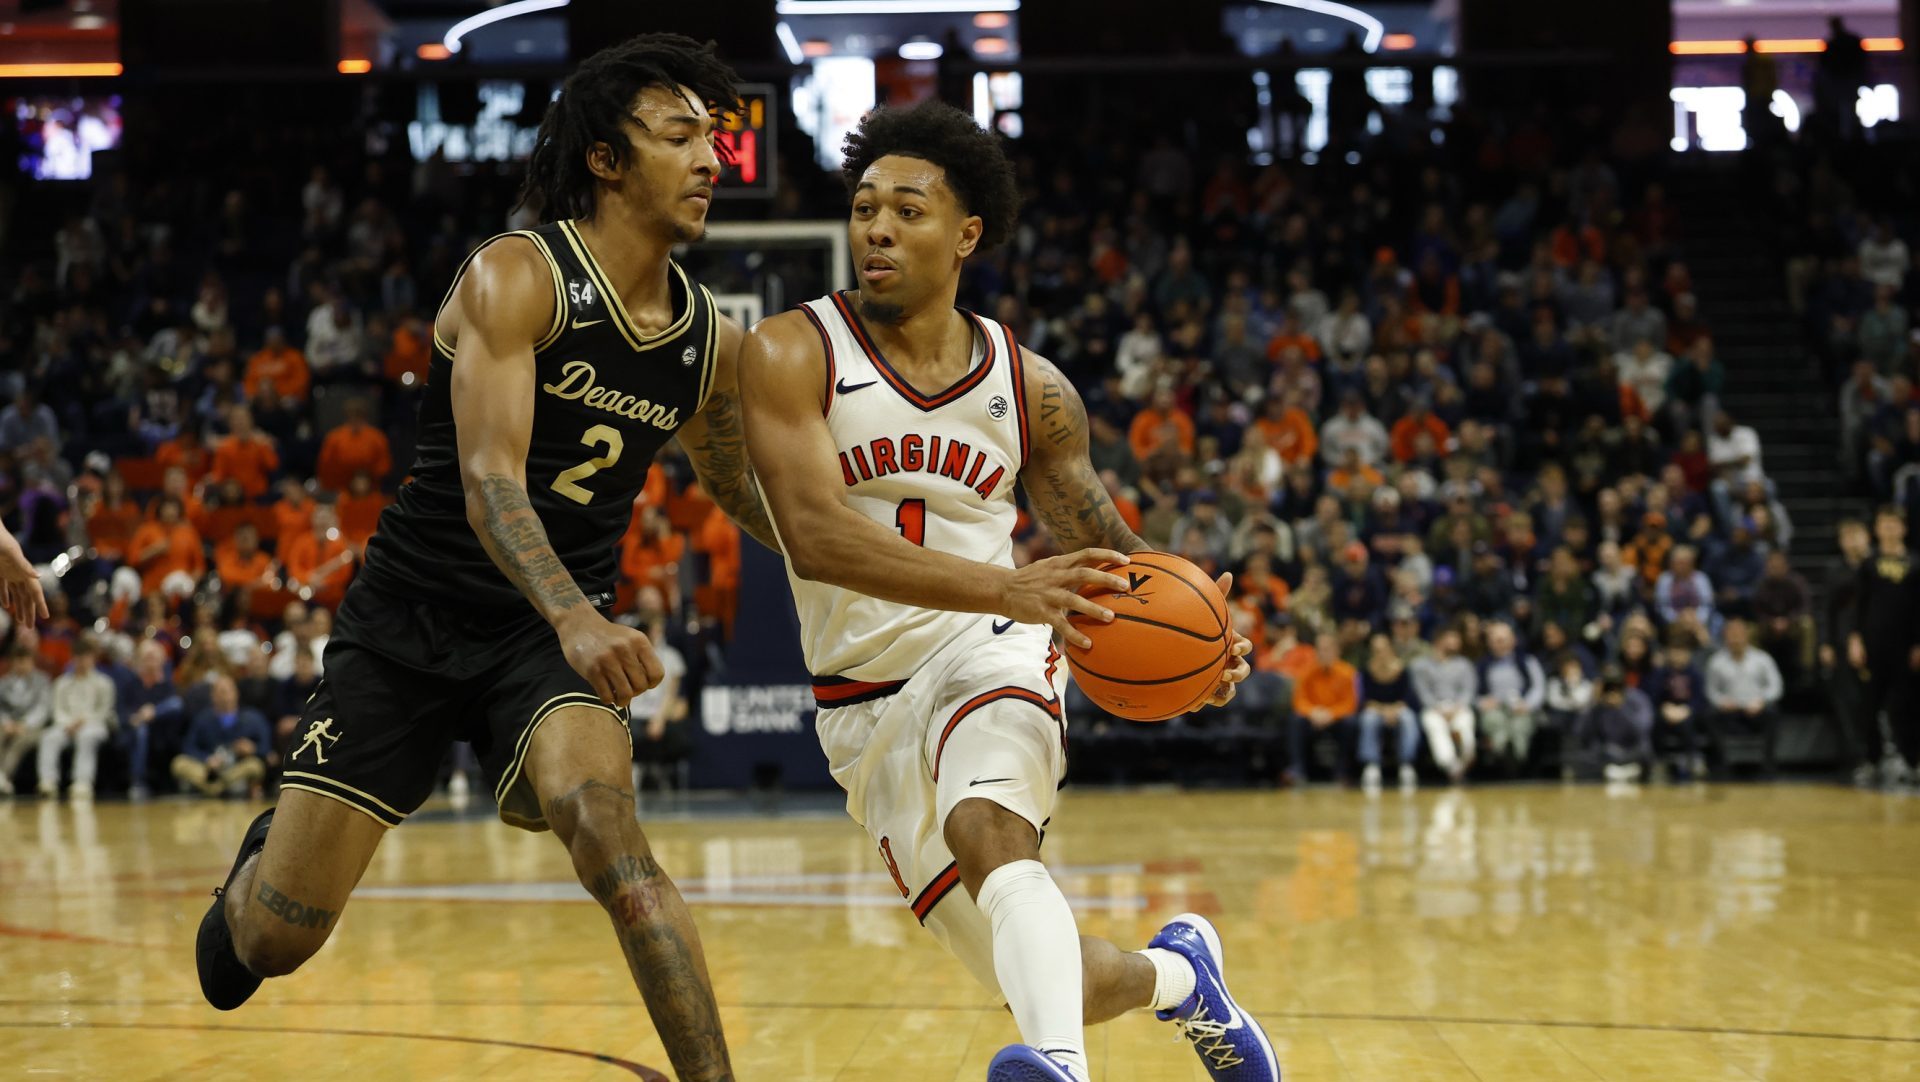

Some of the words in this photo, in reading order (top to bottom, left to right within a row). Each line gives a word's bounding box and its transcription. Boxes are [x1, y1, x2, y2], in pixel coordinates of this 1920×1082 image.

[569, 282, 593, 305] 54
[543, 360, 679, 431] Deacons
[550, 424, 625, 505] 2
[895, 497, 926, 548] 1
[257, 880, 337, 930] EBONY
